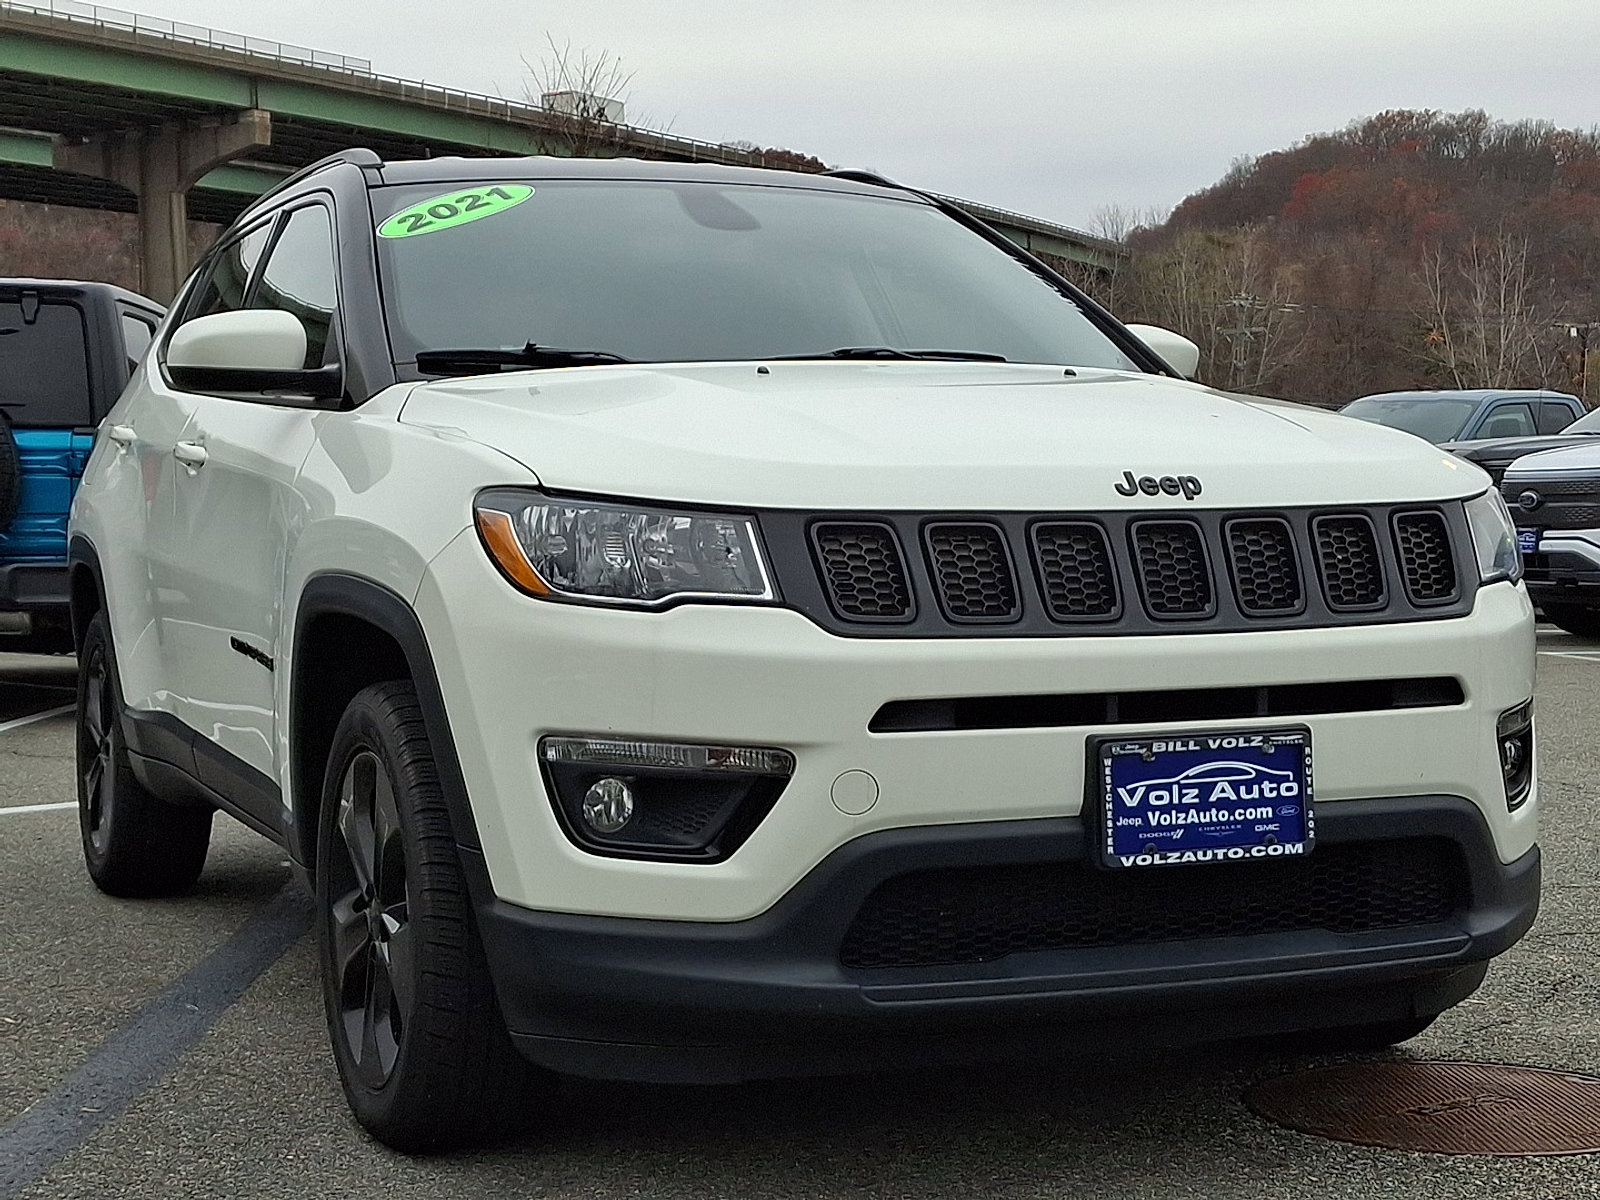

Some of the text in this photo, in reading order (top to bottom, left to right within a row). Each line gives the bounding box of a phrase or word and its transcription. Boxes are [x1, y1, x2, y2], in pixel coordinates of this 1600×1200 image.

[397, 187, 514, 232] 2021
[1114, 471, 1202, 501] Jeep
[1152, 736, 1264, 753] BILL VOLZ
[1116, 780, 1299, 807] Volz Auto
[1304, 746, 1315, 838] ROUTE 202
[1103, 758, 1114, 855] WESTCHESTER
[1147, 806, 1273, 826] VolzAuto.com
[1116, 816, 1142, 827] Jeep
[1254, 823, 1280, 832] GMC
[1120, 843, 1304, 867] VOLZAUTO.COM
